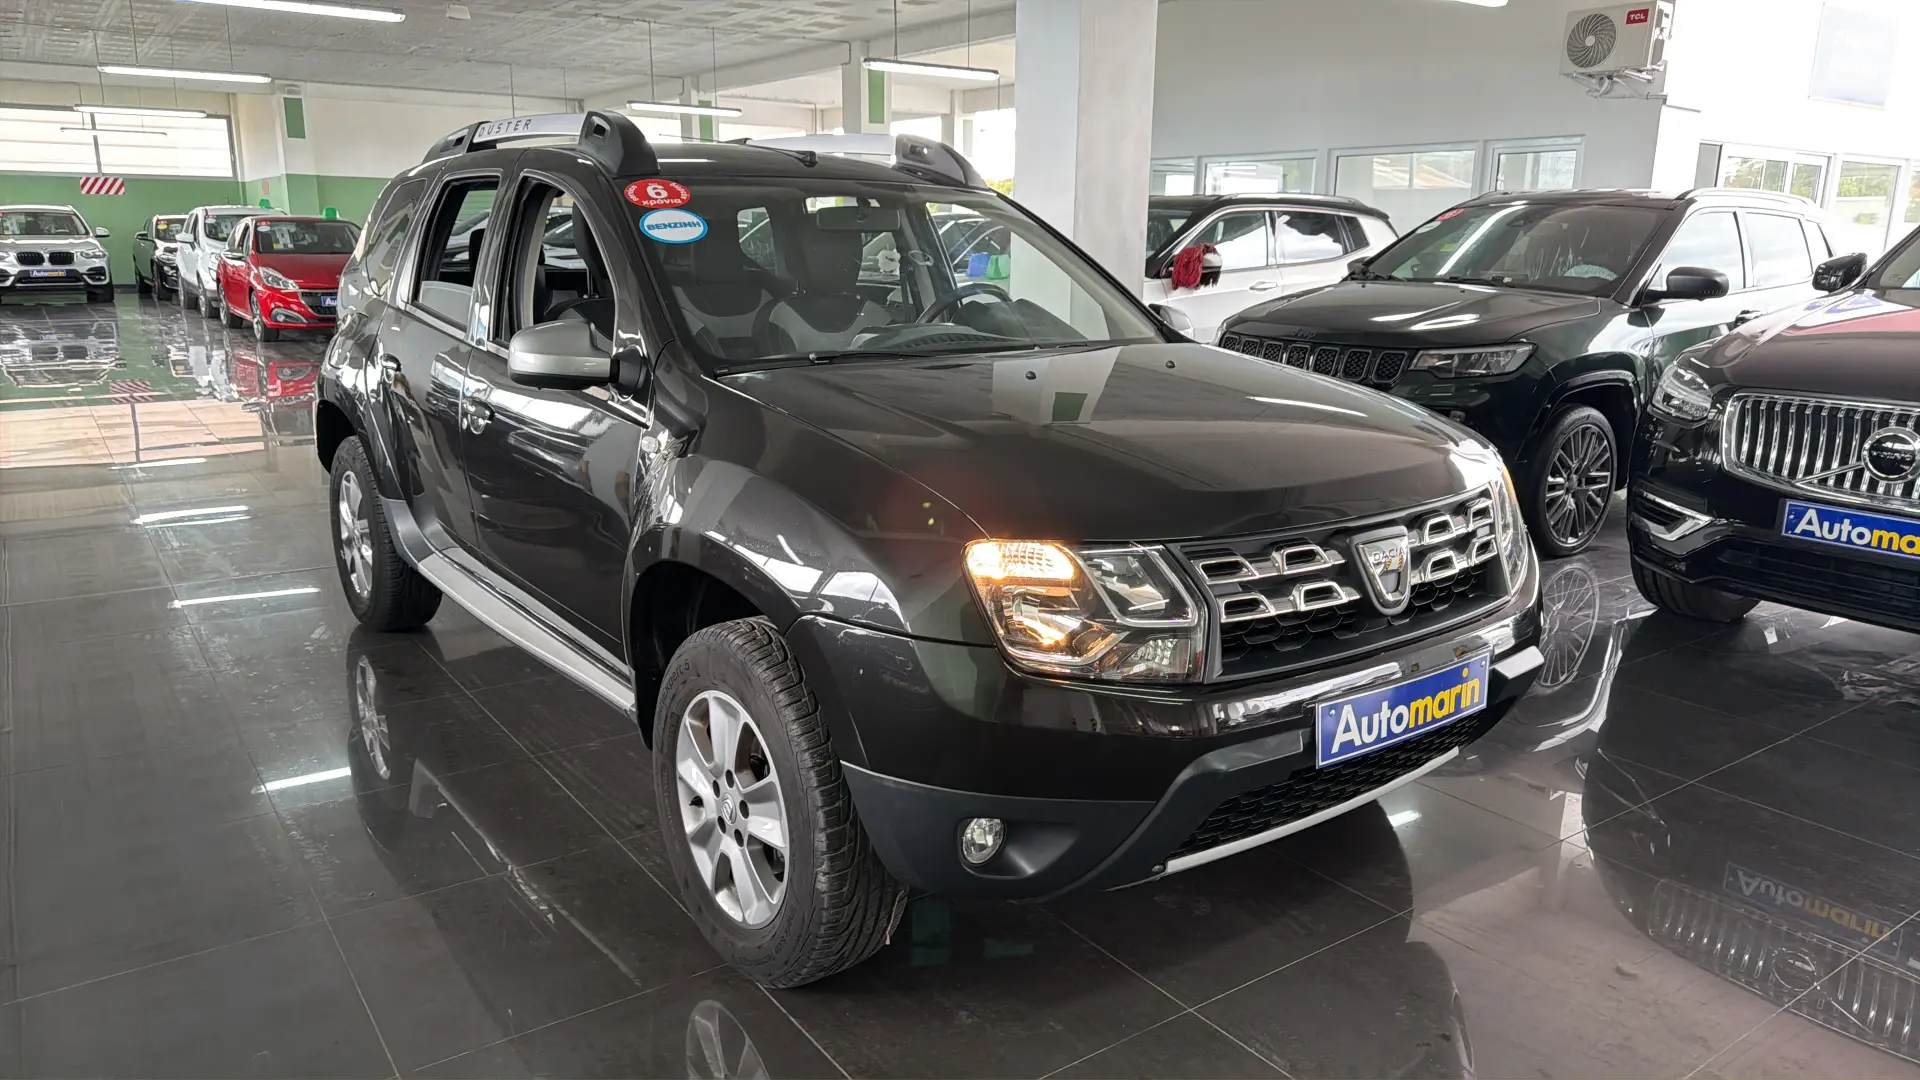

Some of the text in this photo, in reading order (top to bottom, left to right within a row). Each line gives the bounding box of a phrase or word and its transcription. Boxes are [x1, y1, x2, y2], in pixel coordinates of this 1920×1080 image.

[478, 118, 532, 136] DUSTER
[646, 184, 668, 199] 6
[641, 198, 682, 206] χρόνια
[1372, 548, 1406, 562] DACIA
[1331, 668, 1480, 754] Automarin
